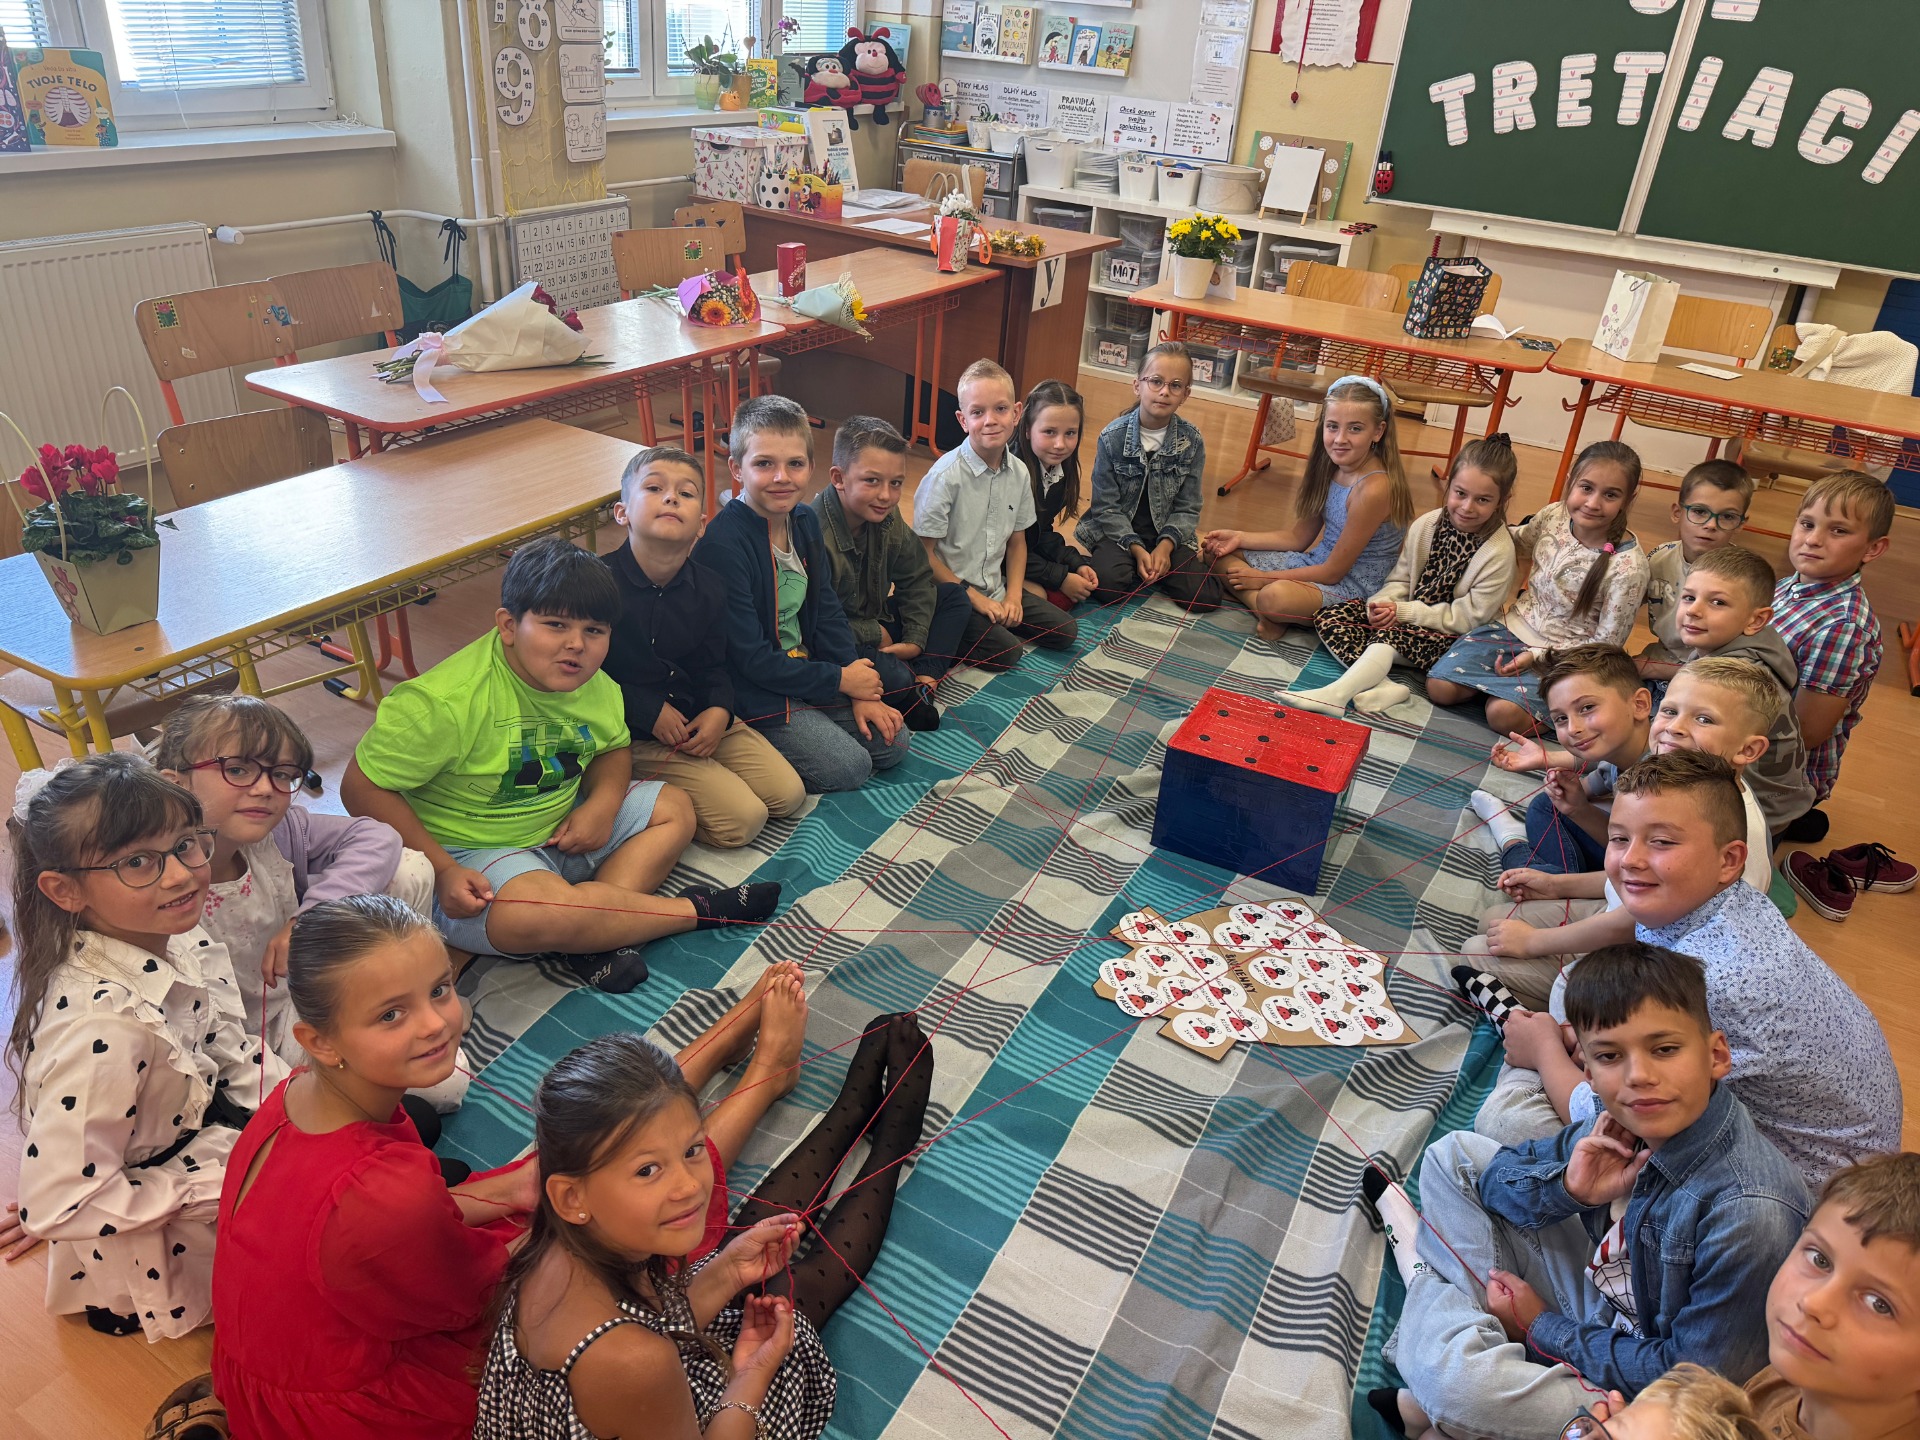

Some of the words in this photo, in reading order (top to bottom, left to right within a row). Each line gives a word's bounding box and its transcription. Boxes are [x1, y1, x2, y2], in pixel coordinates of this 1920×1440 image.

[27, 75, 63, 89] TVOJE
[67, 76, 97, 92] TELO
[1004, 86, 1019, 94] DLHÝ
[1062, 96, 1095, 106] PRAVIDLÁ
[1429, 51, 1920, 184] TRETIACI
[523, 229, 525, 238] 1
[534, 228, 538, 236] 2
[546, 226, 550, 234] 3
[557, 224, 560, 232] 4
[568, 222, 572, 230] 5
[579, 220, 582, 228] 6
[590, 218, 593, 226] 7
[600, 216, 604, 224] 8
[610, 214, 614, 223] 9
[619, 212, 625, 221] 10
[523, 247, 529, 256] 11
[534, 245, 541, 254] 12
[545, 243, 552, 252] 13
[557, 241, 564, 250] 14
[568, 239, 574, 248] 15
[578, 237, 585, 246] 16
[589, 235, 596, 244] 17
[600, 233, 606, 241] 18
[524, 265, 531, 274] 21
[535, 263, 543, 272] 22
[546, 261, 553, 270] 23
[558, 259, 564, 267] 24
[569, 257, 576, 265] 25
[579, 254, 586, 263] 26
[590, 252, 597, 261] 27
[600, 250, 607, 258] 28
[1113, 264, 1137, 280] MAT
[548, 278, 555, 287] 33
[559, 276, 566, 284] 34
[570, 273, 577, 282] 35
[581, 271, 587, 280] 36
[591, 269, 597, 277] 37
[602, 266, 608, 275] 38
[560, 292, 567, 301] 44
[571, 290, 578, 299] 45
[581, 288, 589, 296] 46
[592, 285, 599, 294] 47
[602, 283, 609, 291] 48
[612, 281, 619, 290] 49
[1184, 1029, 1197, 1041] IVAN
